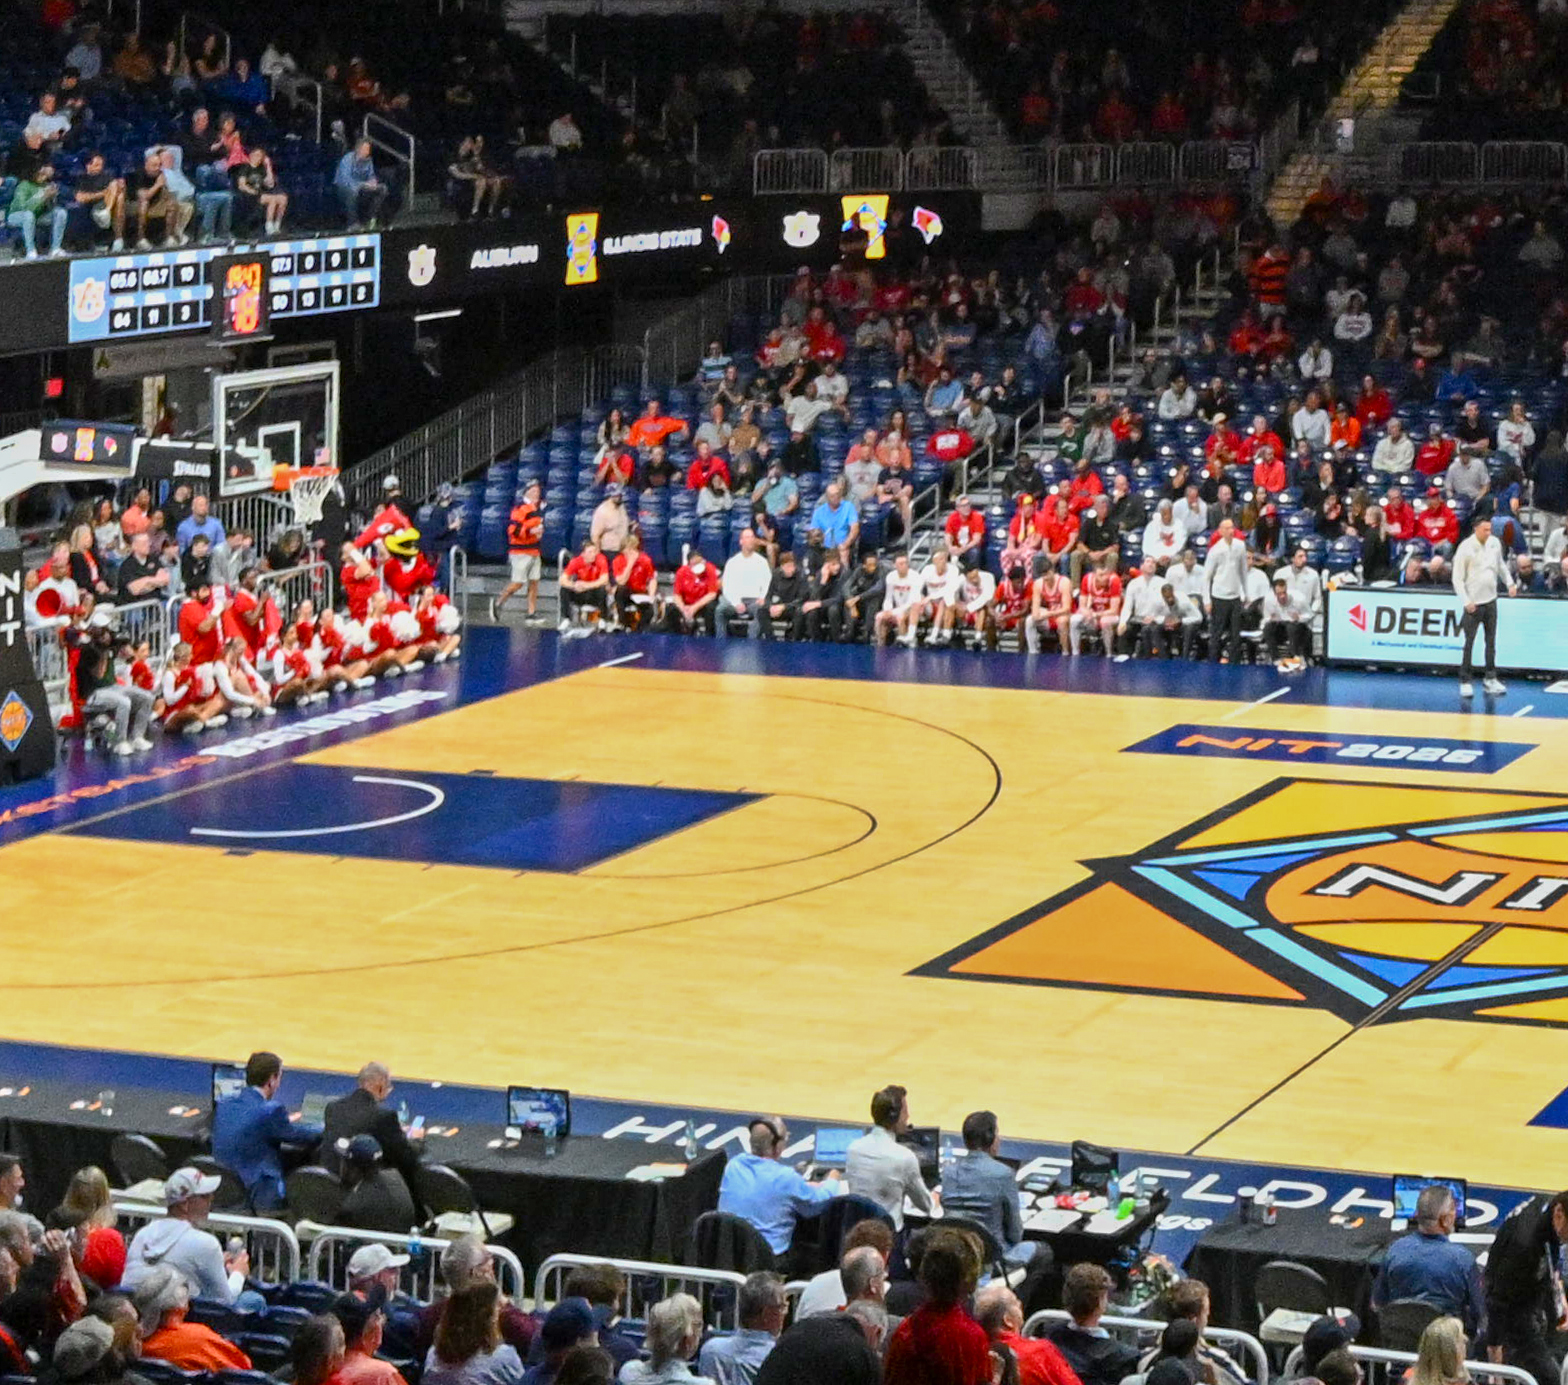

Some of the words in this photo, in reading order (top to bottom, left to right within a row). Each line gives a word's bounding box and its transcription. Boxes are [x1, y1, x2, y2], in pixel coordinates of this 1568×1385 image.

[1373, 605, 1466, 638] DEEM
[1176, 734, 1342, 753] NIT
[1336, 743, 1484, 763] 2026
